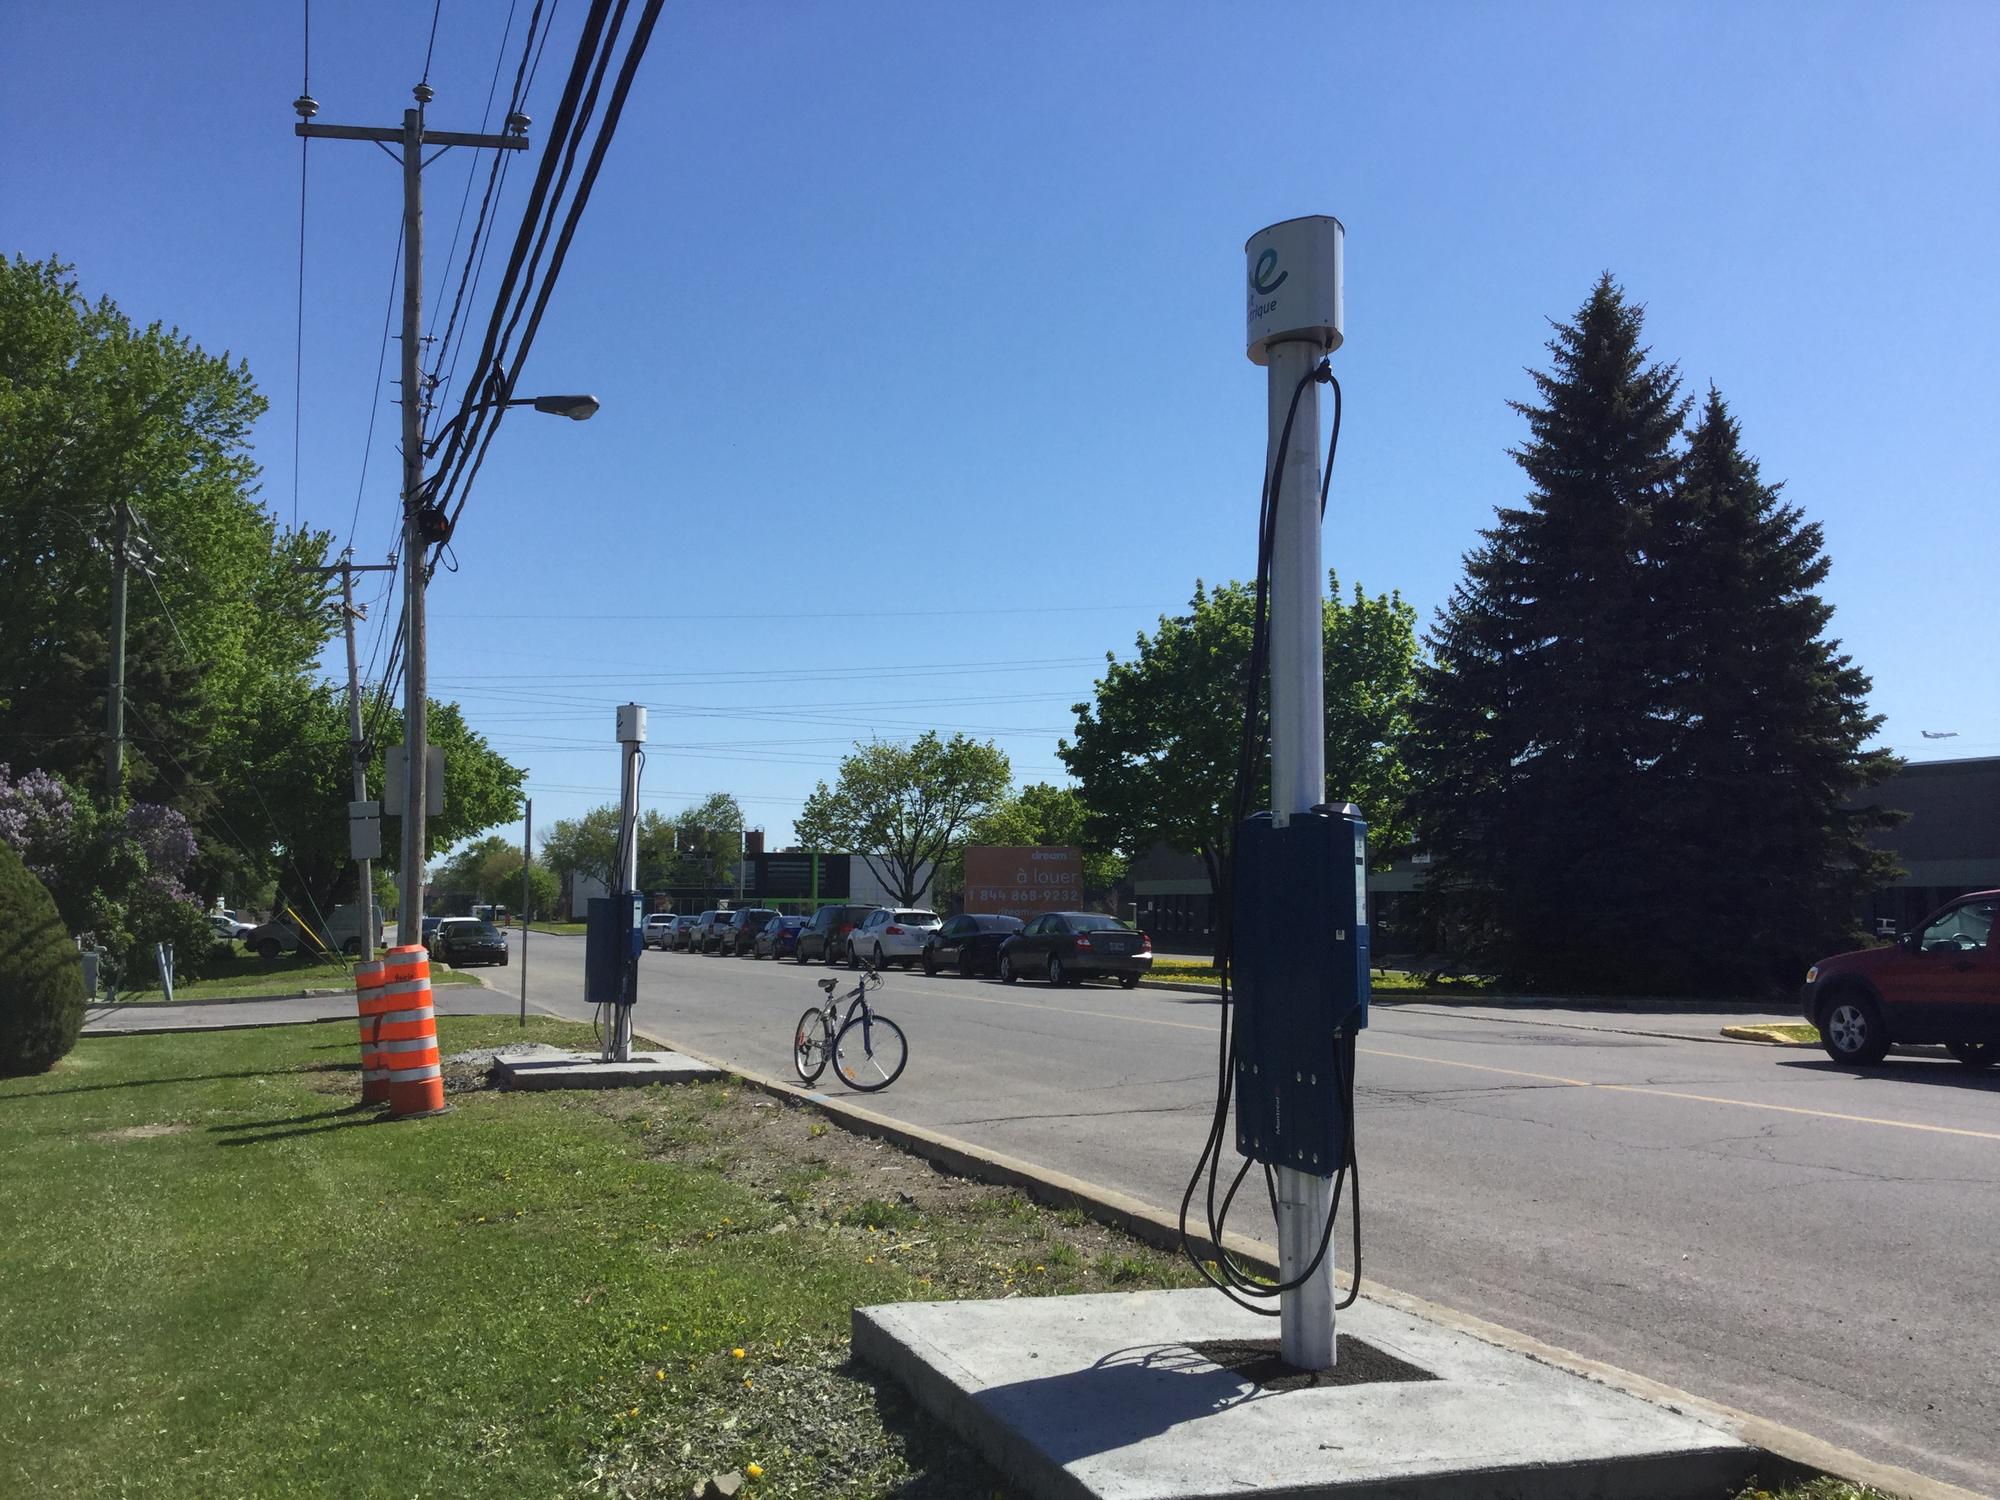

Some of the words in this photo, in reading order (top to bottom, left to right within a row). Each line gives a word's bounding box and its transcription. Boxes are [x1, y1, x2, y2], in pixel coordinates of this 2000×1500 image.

[1017, 867, 1027, 883] à
[1034, 867, 1078, 883] louer
[980, 890, 1006, 901] 844
[1012, 890, 1078, 901] 868-9232
